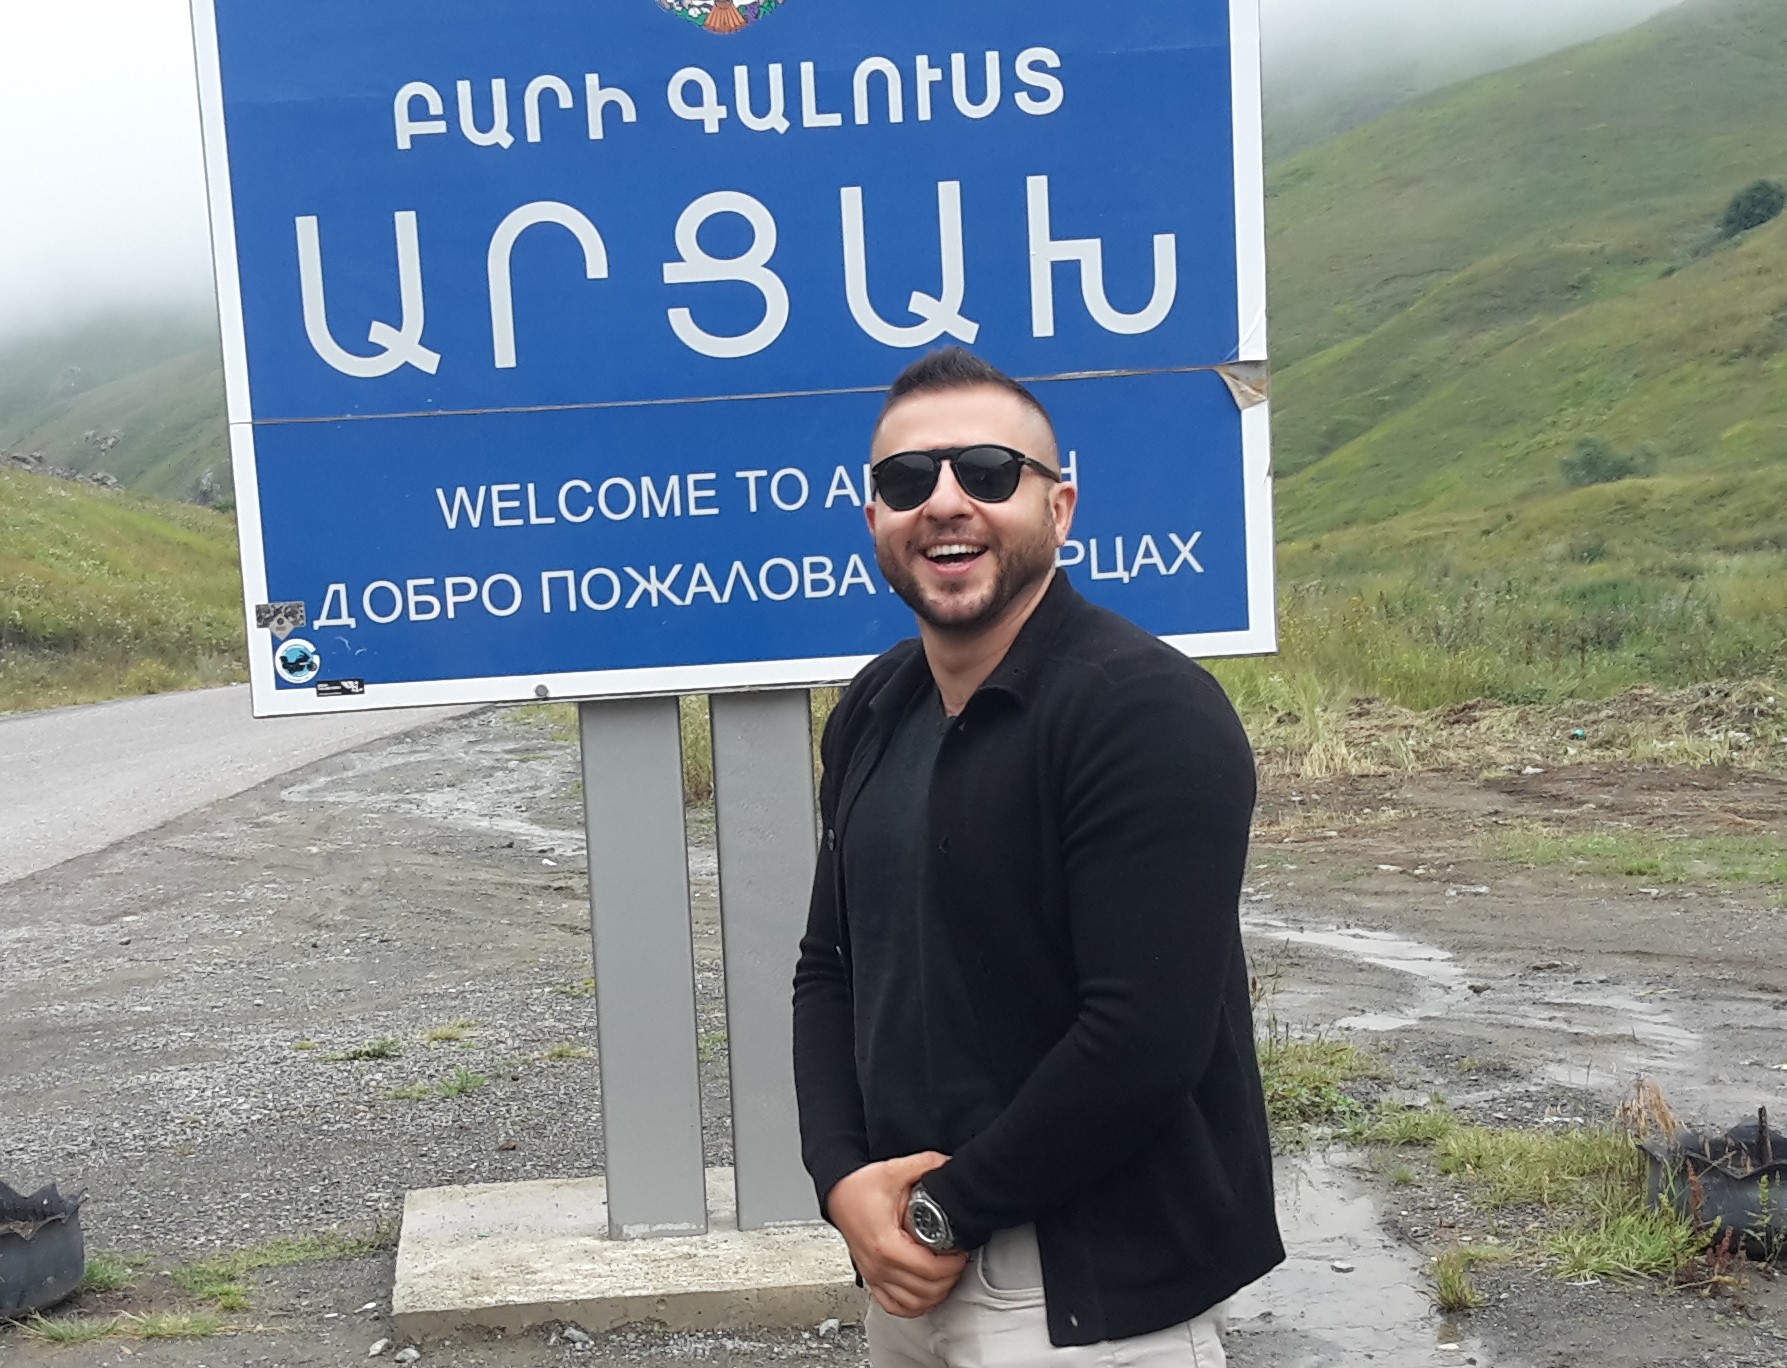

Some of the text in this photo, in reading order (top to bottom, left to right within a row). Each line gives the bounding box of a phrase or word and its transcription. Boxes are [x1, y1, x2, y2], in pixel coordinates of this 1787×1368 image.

[393, 46, 1064, 150] ԲԱՐԻ ԳԱԼՈՒՍՏ
[295, 174, 1177, 378] ԱՐՑԱԽ
[435, 472, 720, 530] WELCOME
[735, 467, 809, 513] TO
[312, 530, 1204, 631] ДОБРО ПОЖАЛОВА РЦАХ
